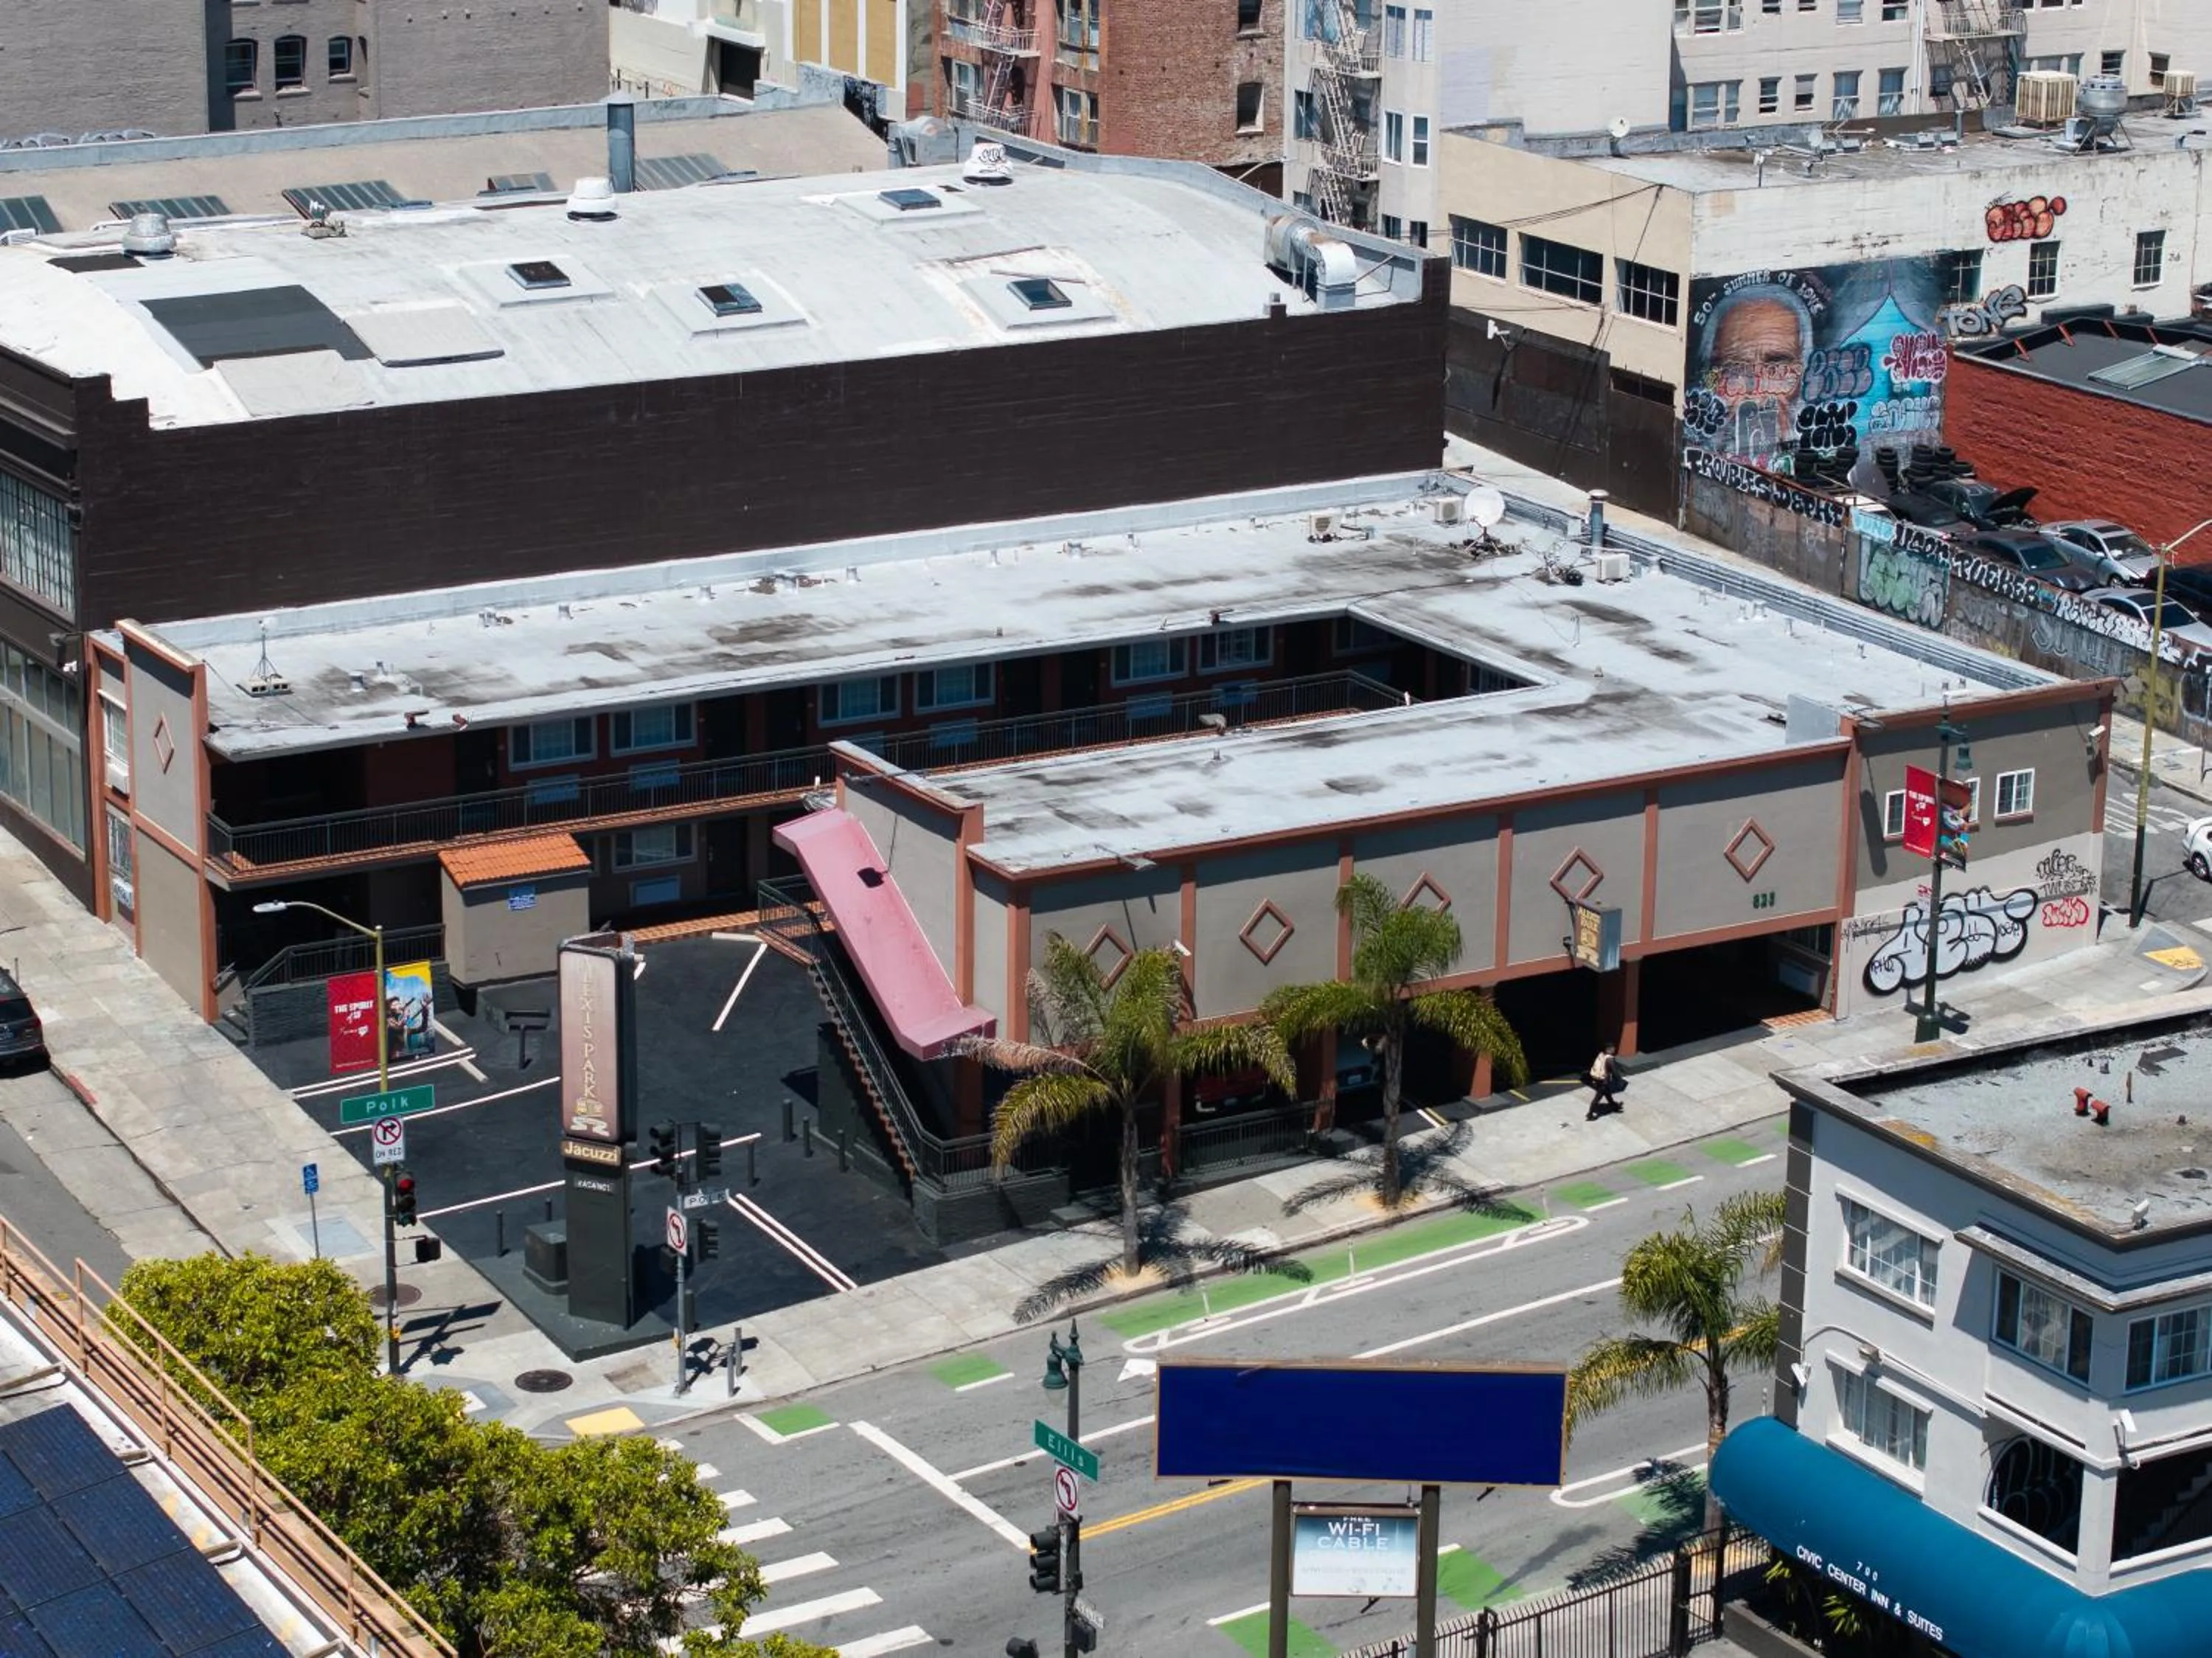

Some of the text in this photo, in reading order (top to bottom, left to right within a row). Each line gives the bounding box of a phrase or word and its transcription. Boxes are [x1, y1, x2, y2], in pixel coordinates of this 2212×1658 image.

[1723, 268, 1770, 295] SUMMER
[334, 1000, 374, 1013] THE SPIRIT
[583, 1043, 596, 1098] PARK
[366, 1096, 408, 1113] Polk
[564, 1141, 618, 1162] Jacuzzi
[1328, 1522, 1380, 1536] WI-FI
[1317, 1536, 1388, 1550] CABLE
[1856, 1561, 1878, 1581] 700
[1796, 1544, 1944, 1641] CIVIC CENTER INN & SUITES
